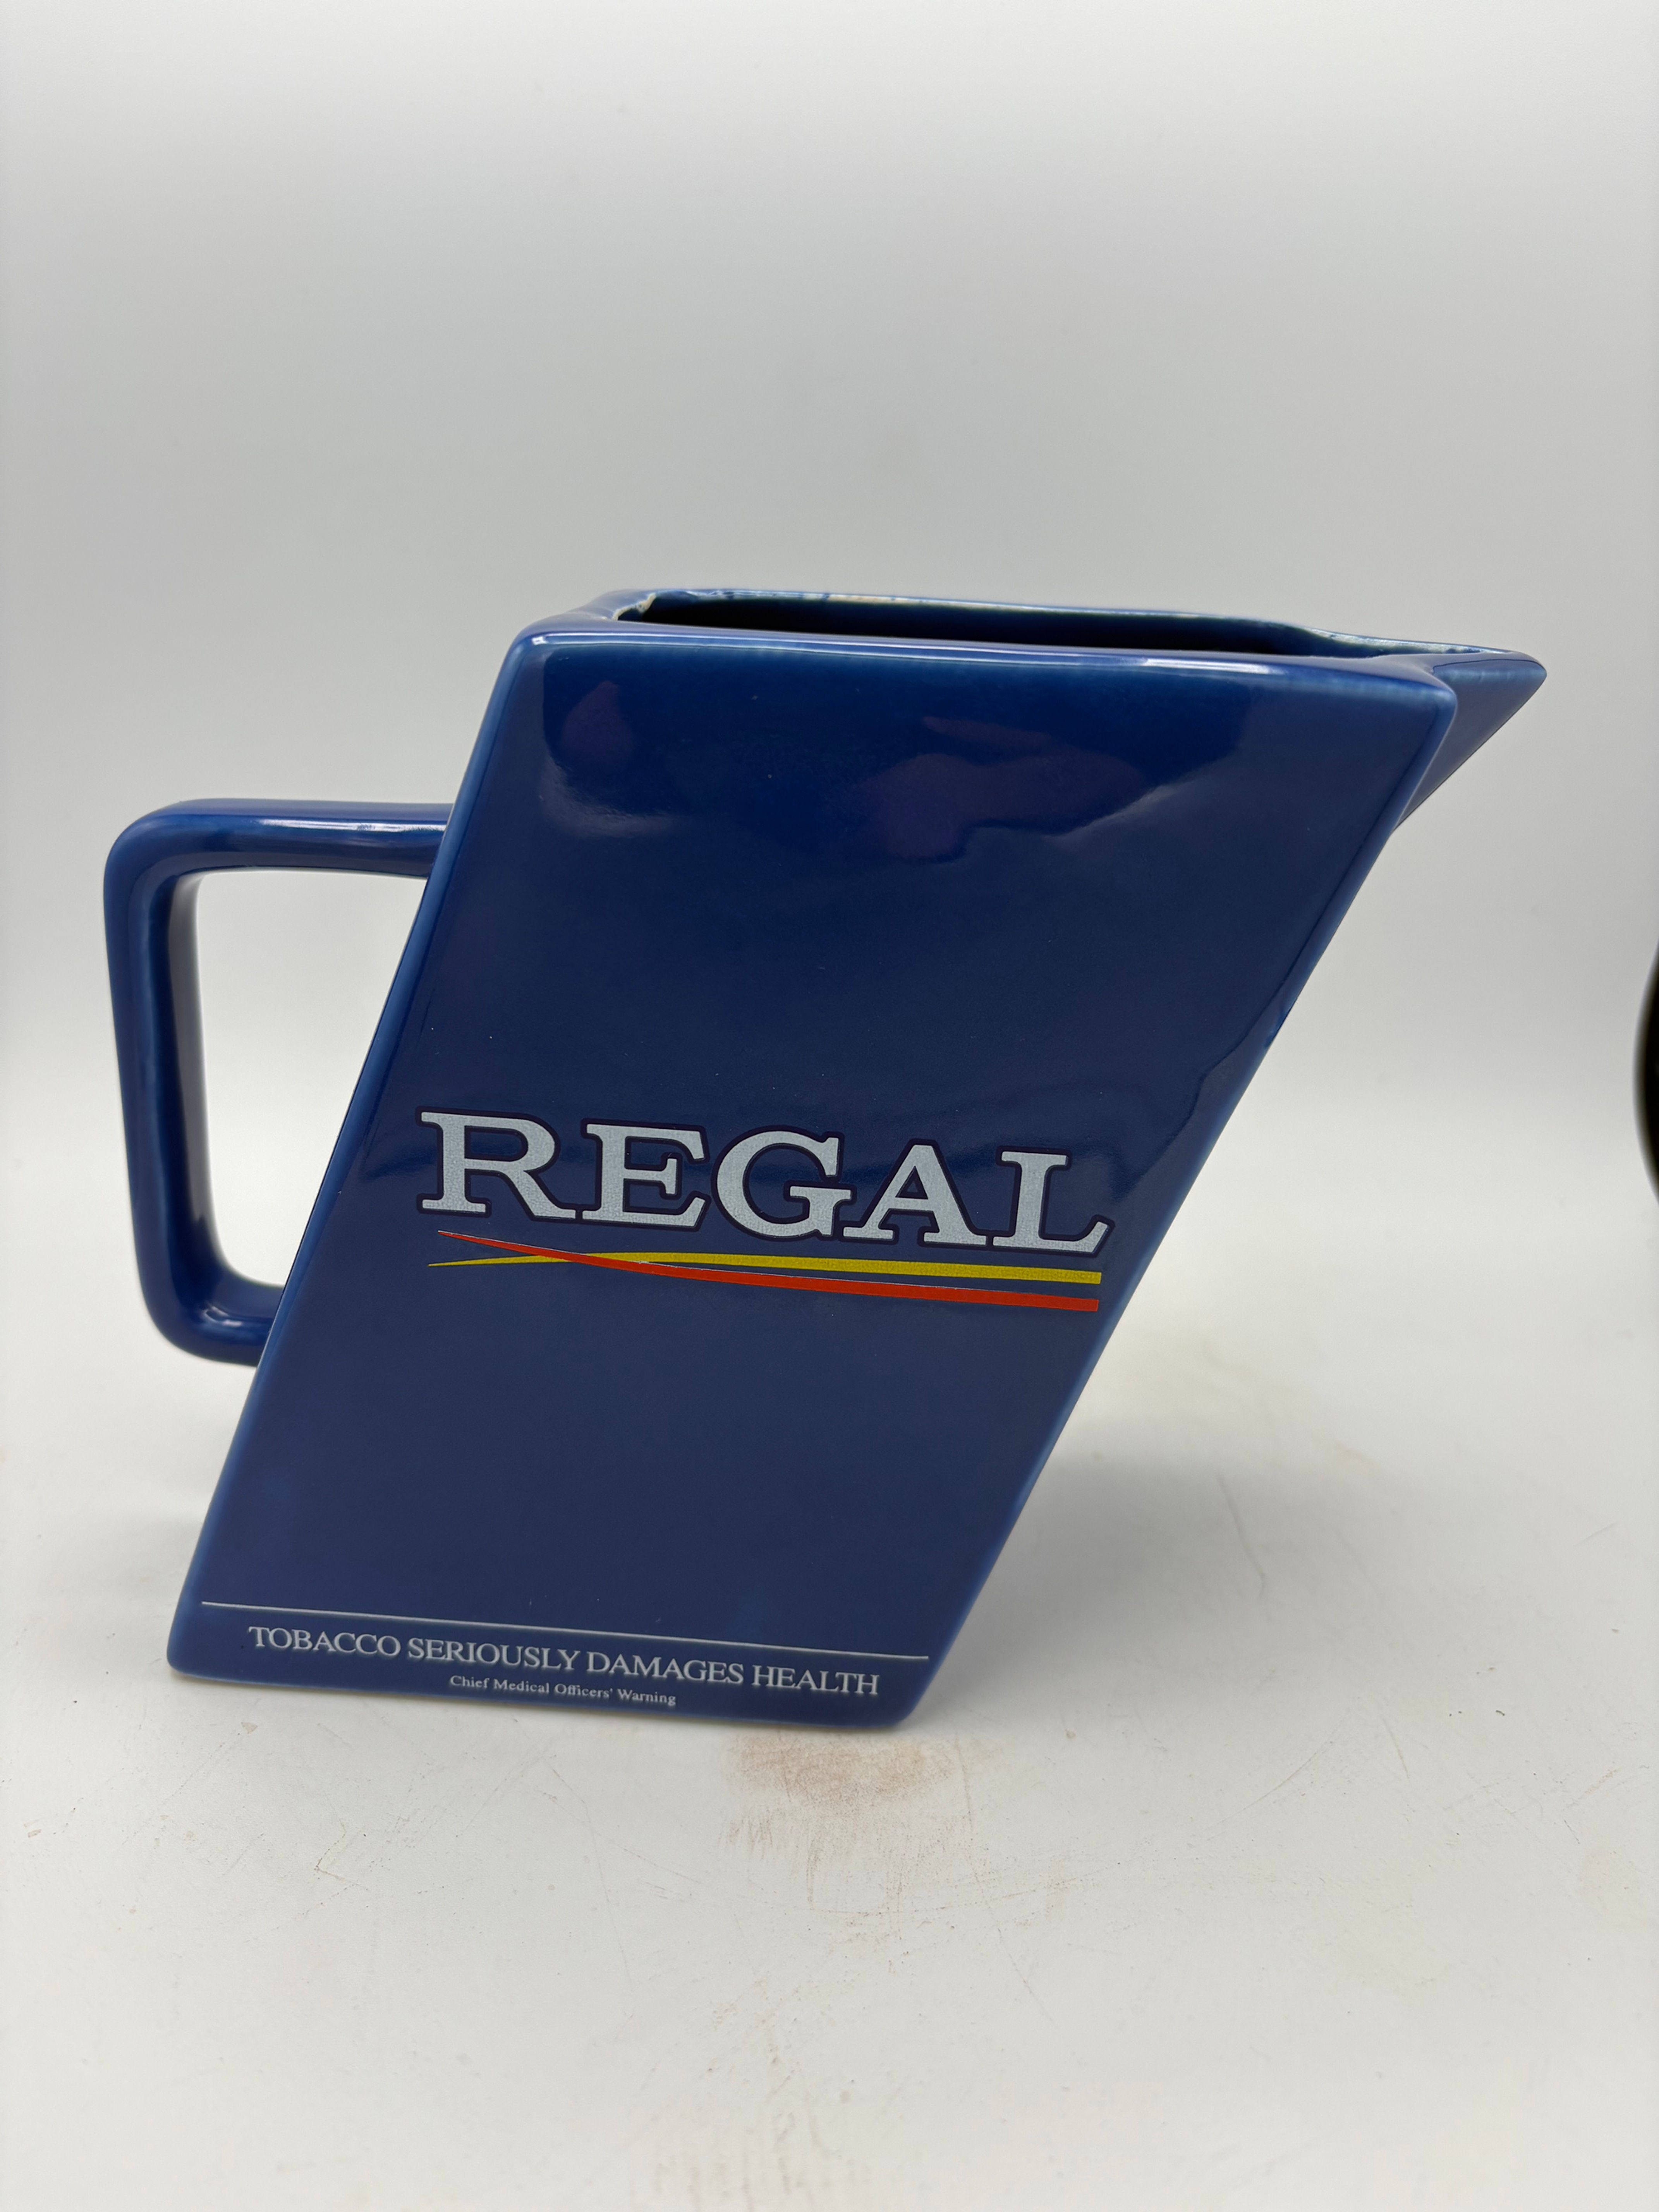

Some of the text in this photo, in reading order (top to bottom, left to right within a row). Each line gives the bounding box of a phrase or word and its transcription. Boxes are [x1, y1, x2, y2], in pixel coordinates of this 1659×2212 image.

[420, 1111, 1110, 1254] REGAL
[248, 1626, 880, 1695] TOBACCO SERIOUSLY DAMAGES HEALTH
[450, 1675, 676, 1707] Chief Medical Officers' Warning
